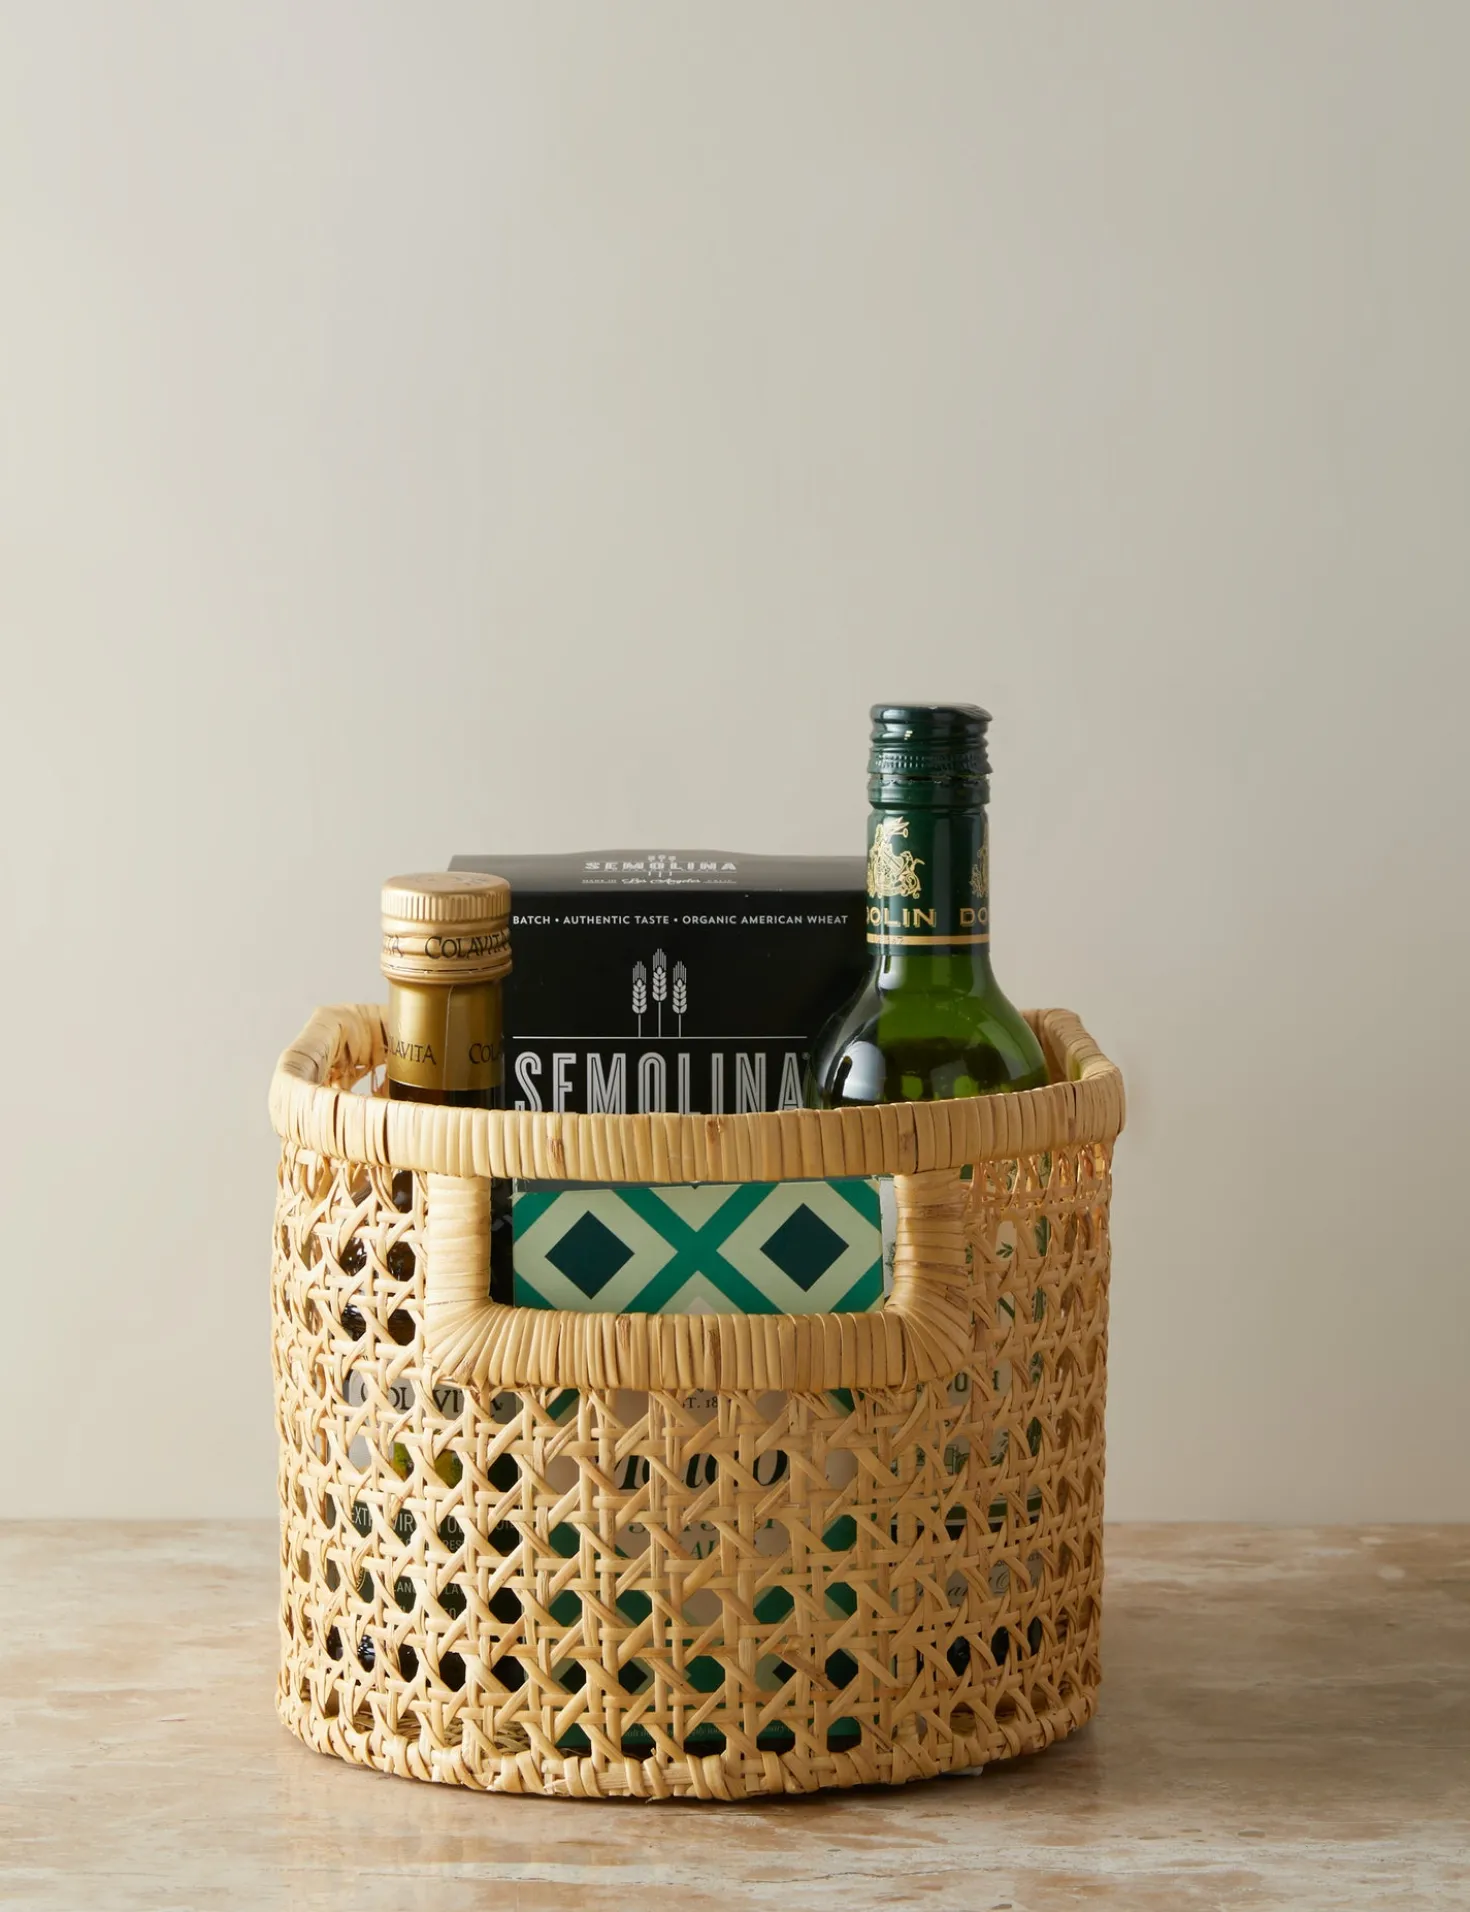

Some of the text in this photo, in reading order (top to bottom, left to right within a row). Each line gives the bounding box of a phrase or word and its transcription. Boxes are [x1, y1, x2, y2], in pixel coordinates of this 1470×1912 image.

[584, 861, 737, 871] SEMOLINA
[512, 915, 849, 925] BATCH AUTHENTIC TASTE ORGANIC AMERICAN WHEAT
[424, 931, 508, 960] COLAVITA
[514, 1051, 804, 1115] SEMOLINA
